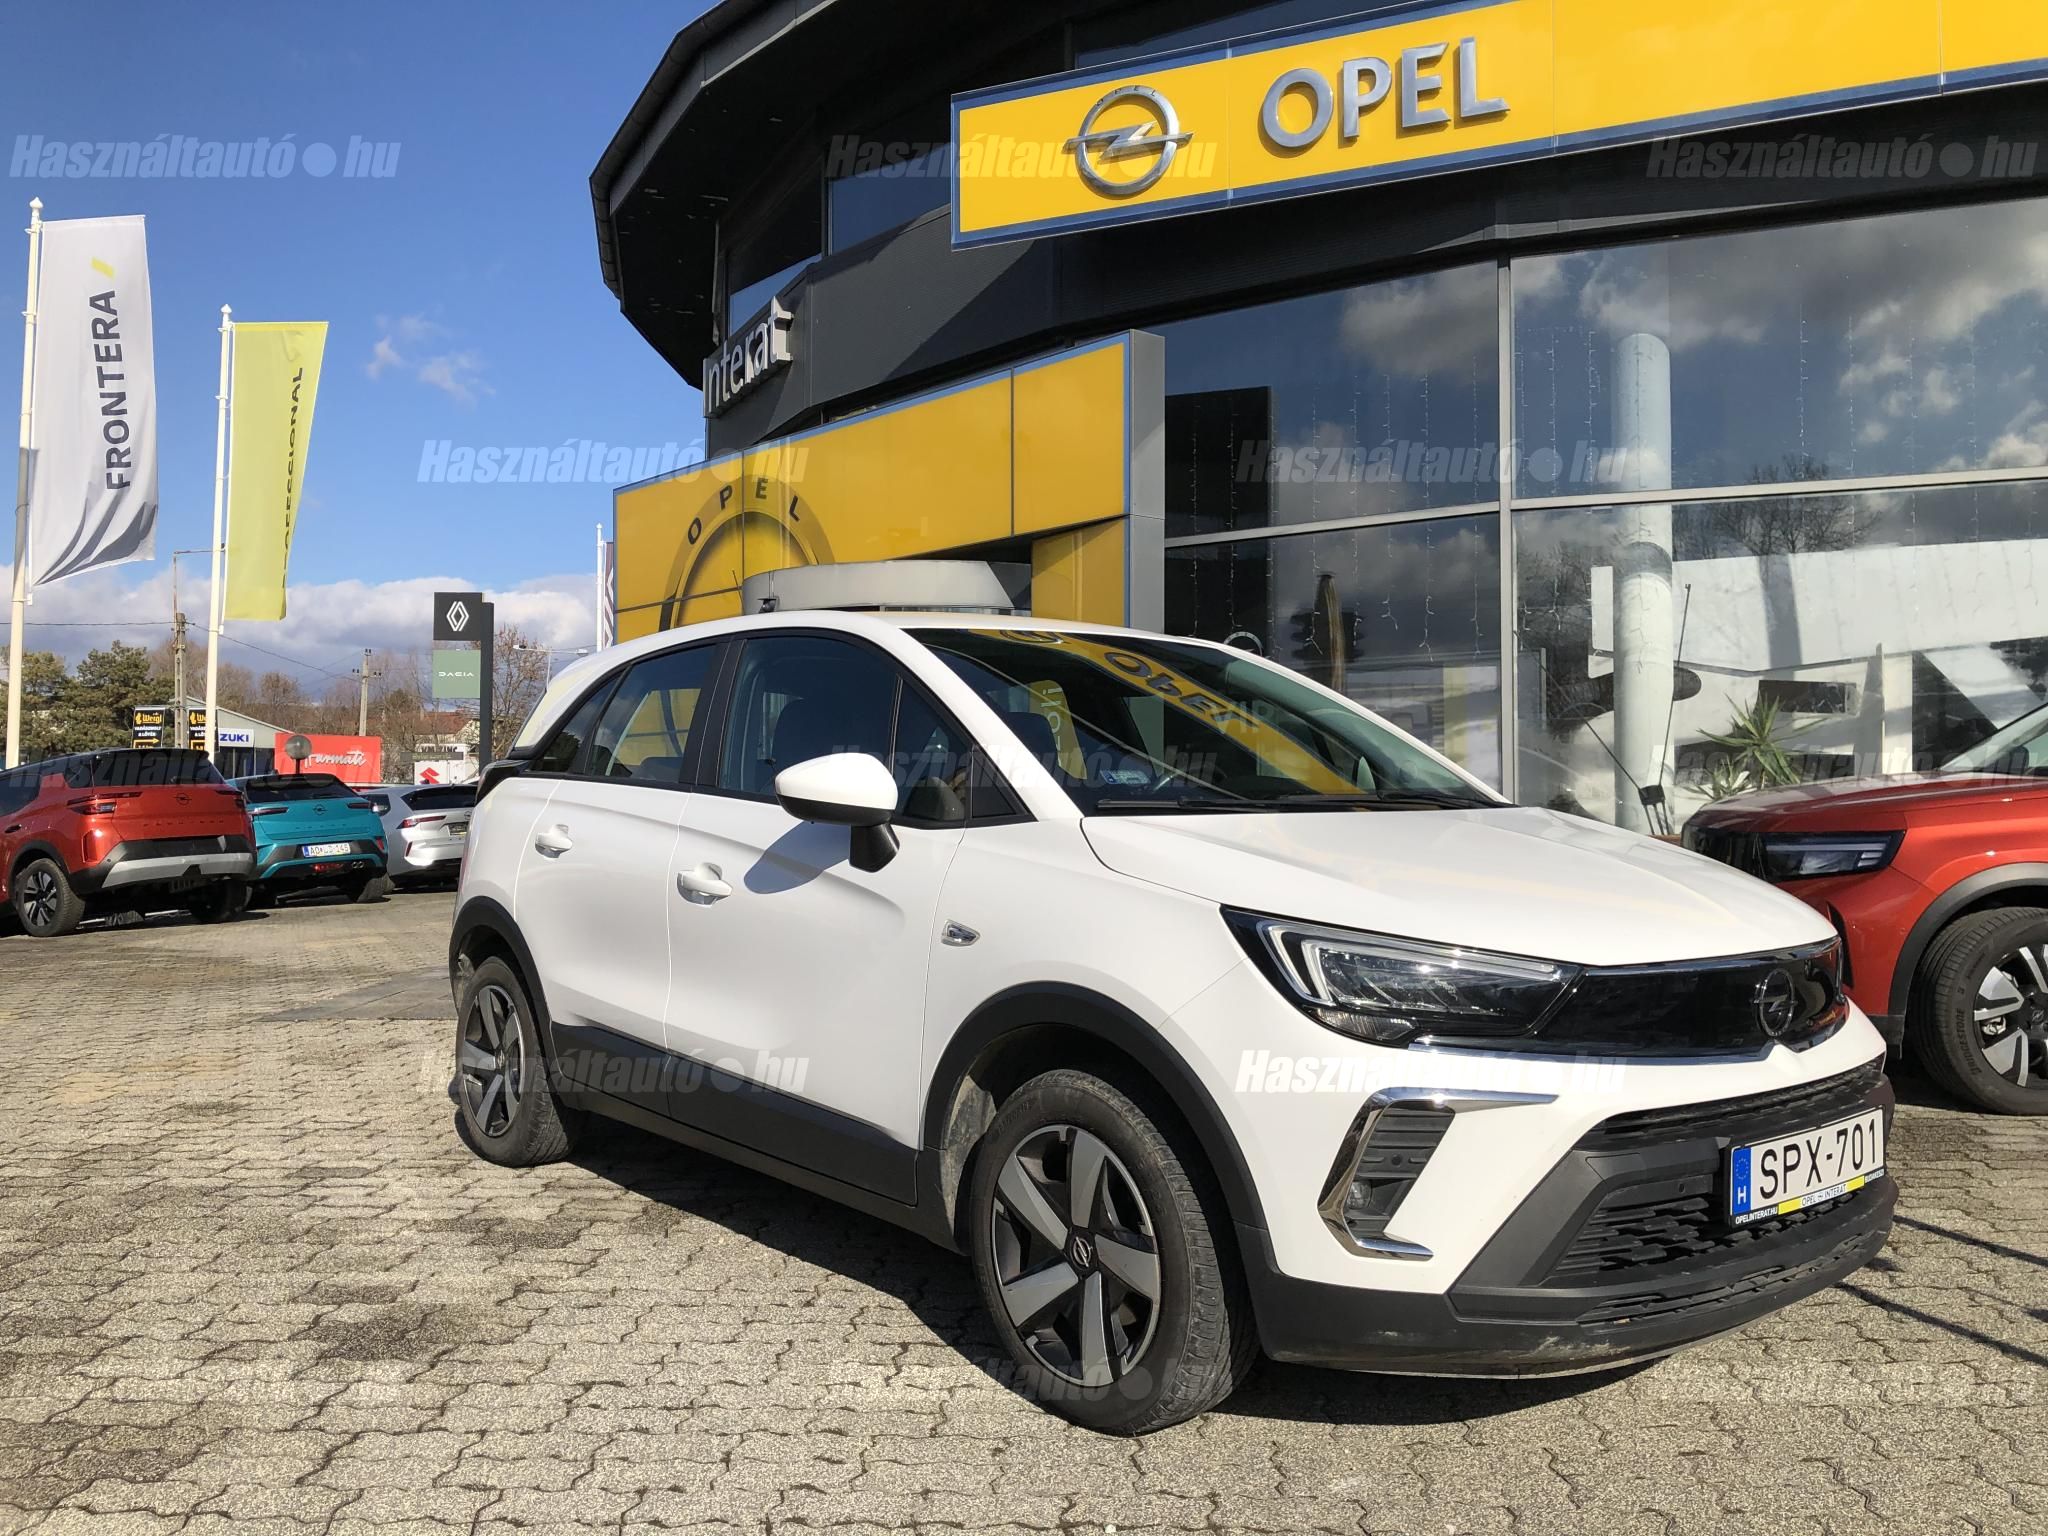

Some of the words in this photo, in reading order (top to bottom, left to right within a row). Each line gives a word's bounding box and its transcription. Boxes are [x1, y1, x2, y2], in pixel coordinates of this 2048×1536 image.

[1263, 36, 1511, 148] OPEL
[89, 290, 132, 490] FRONTERA
[687, 477, 800, 546] OPEL
[220, 733, 249, 742] ZUKI
[1737, 1185, 1747, 1205] H
[1759, 1118, 1876, 1200] SPX-701
